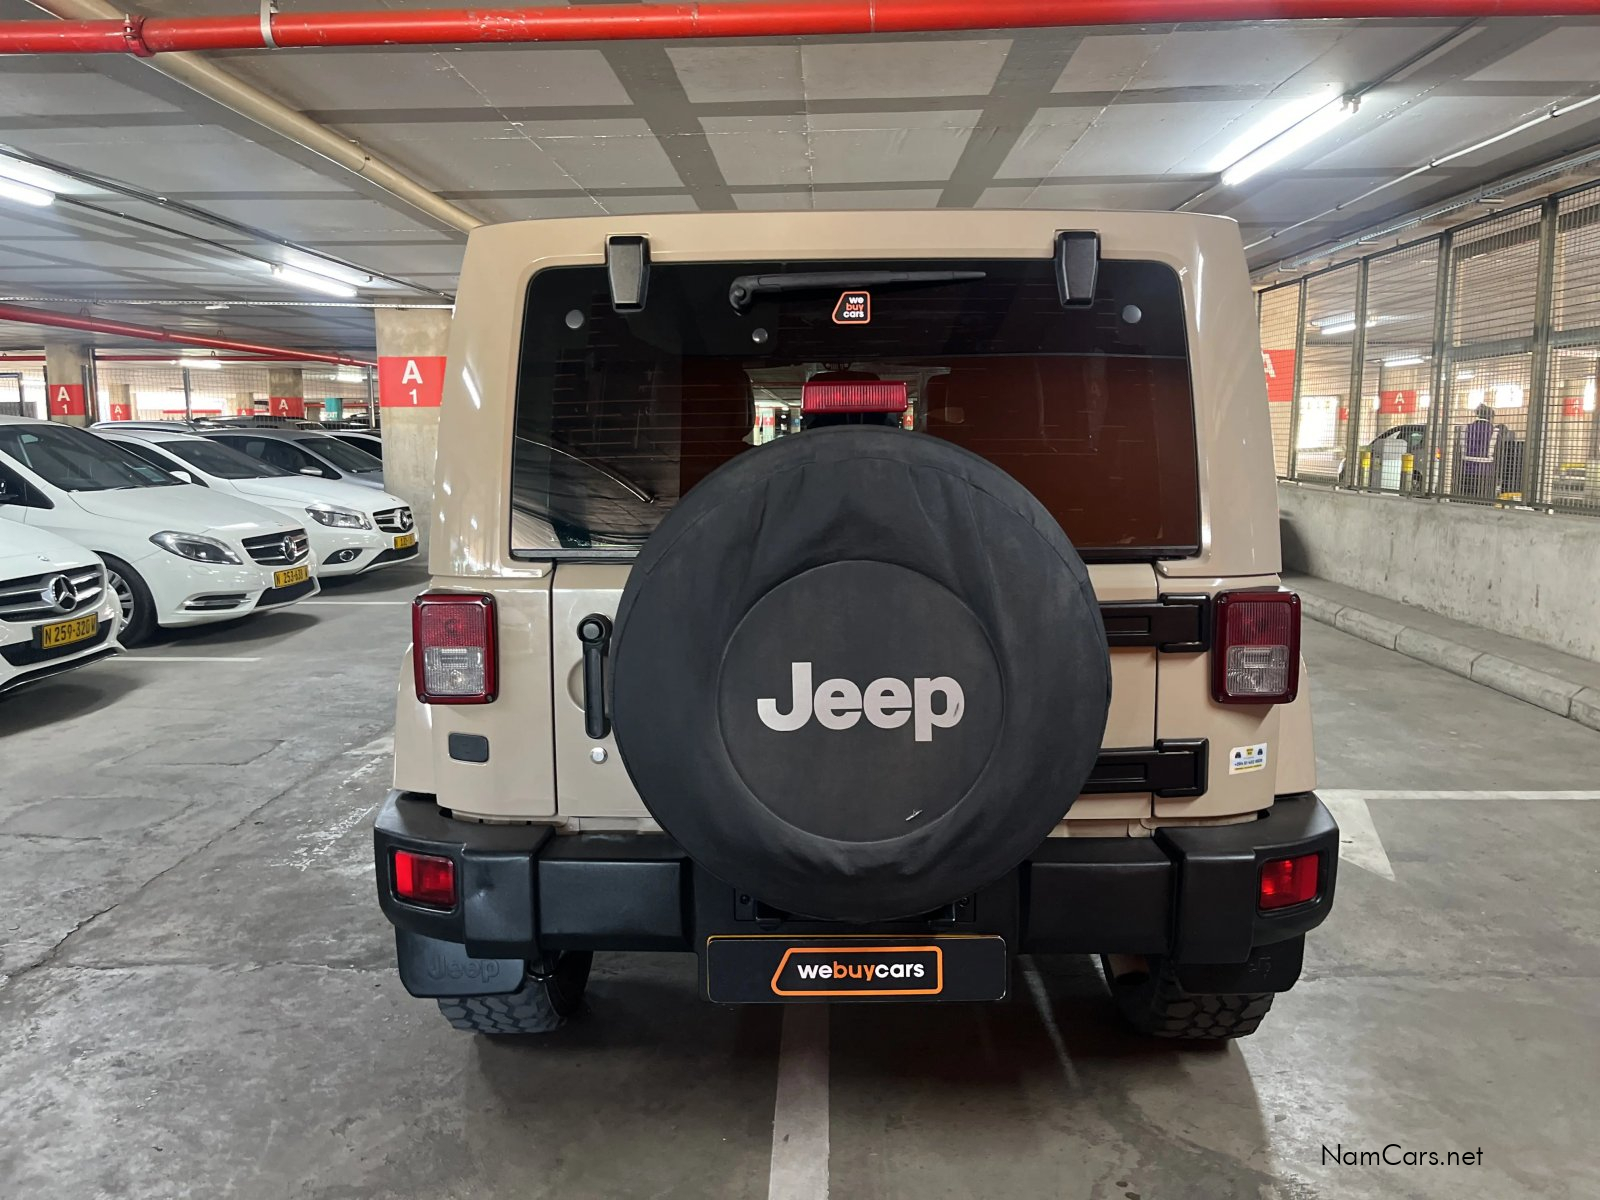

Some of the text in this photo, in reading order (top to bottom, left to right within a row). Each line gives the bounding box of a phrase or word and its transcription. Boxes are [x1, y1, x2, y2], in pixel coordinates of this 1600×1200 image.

[848, 296, 865, 304] we
[842, 310, 865, 318] cars
[845, 303, 864, 312] buy
[401, 359, 423, 385] A
[57, 386, 71, 402] A
[408, 388, 418, 405] 1
[1394, 392, 1405, 404] A
[61, 403, 69, 414] 1
[114, 405, 122, 414] A
[279, 399, 289, 410] A
[45, 627, 52, 645] N
[757, 662, 965, 741] Jeep
[427, 955, 500, 983] Jeep
[797, 960, 925, 981] webuycars
